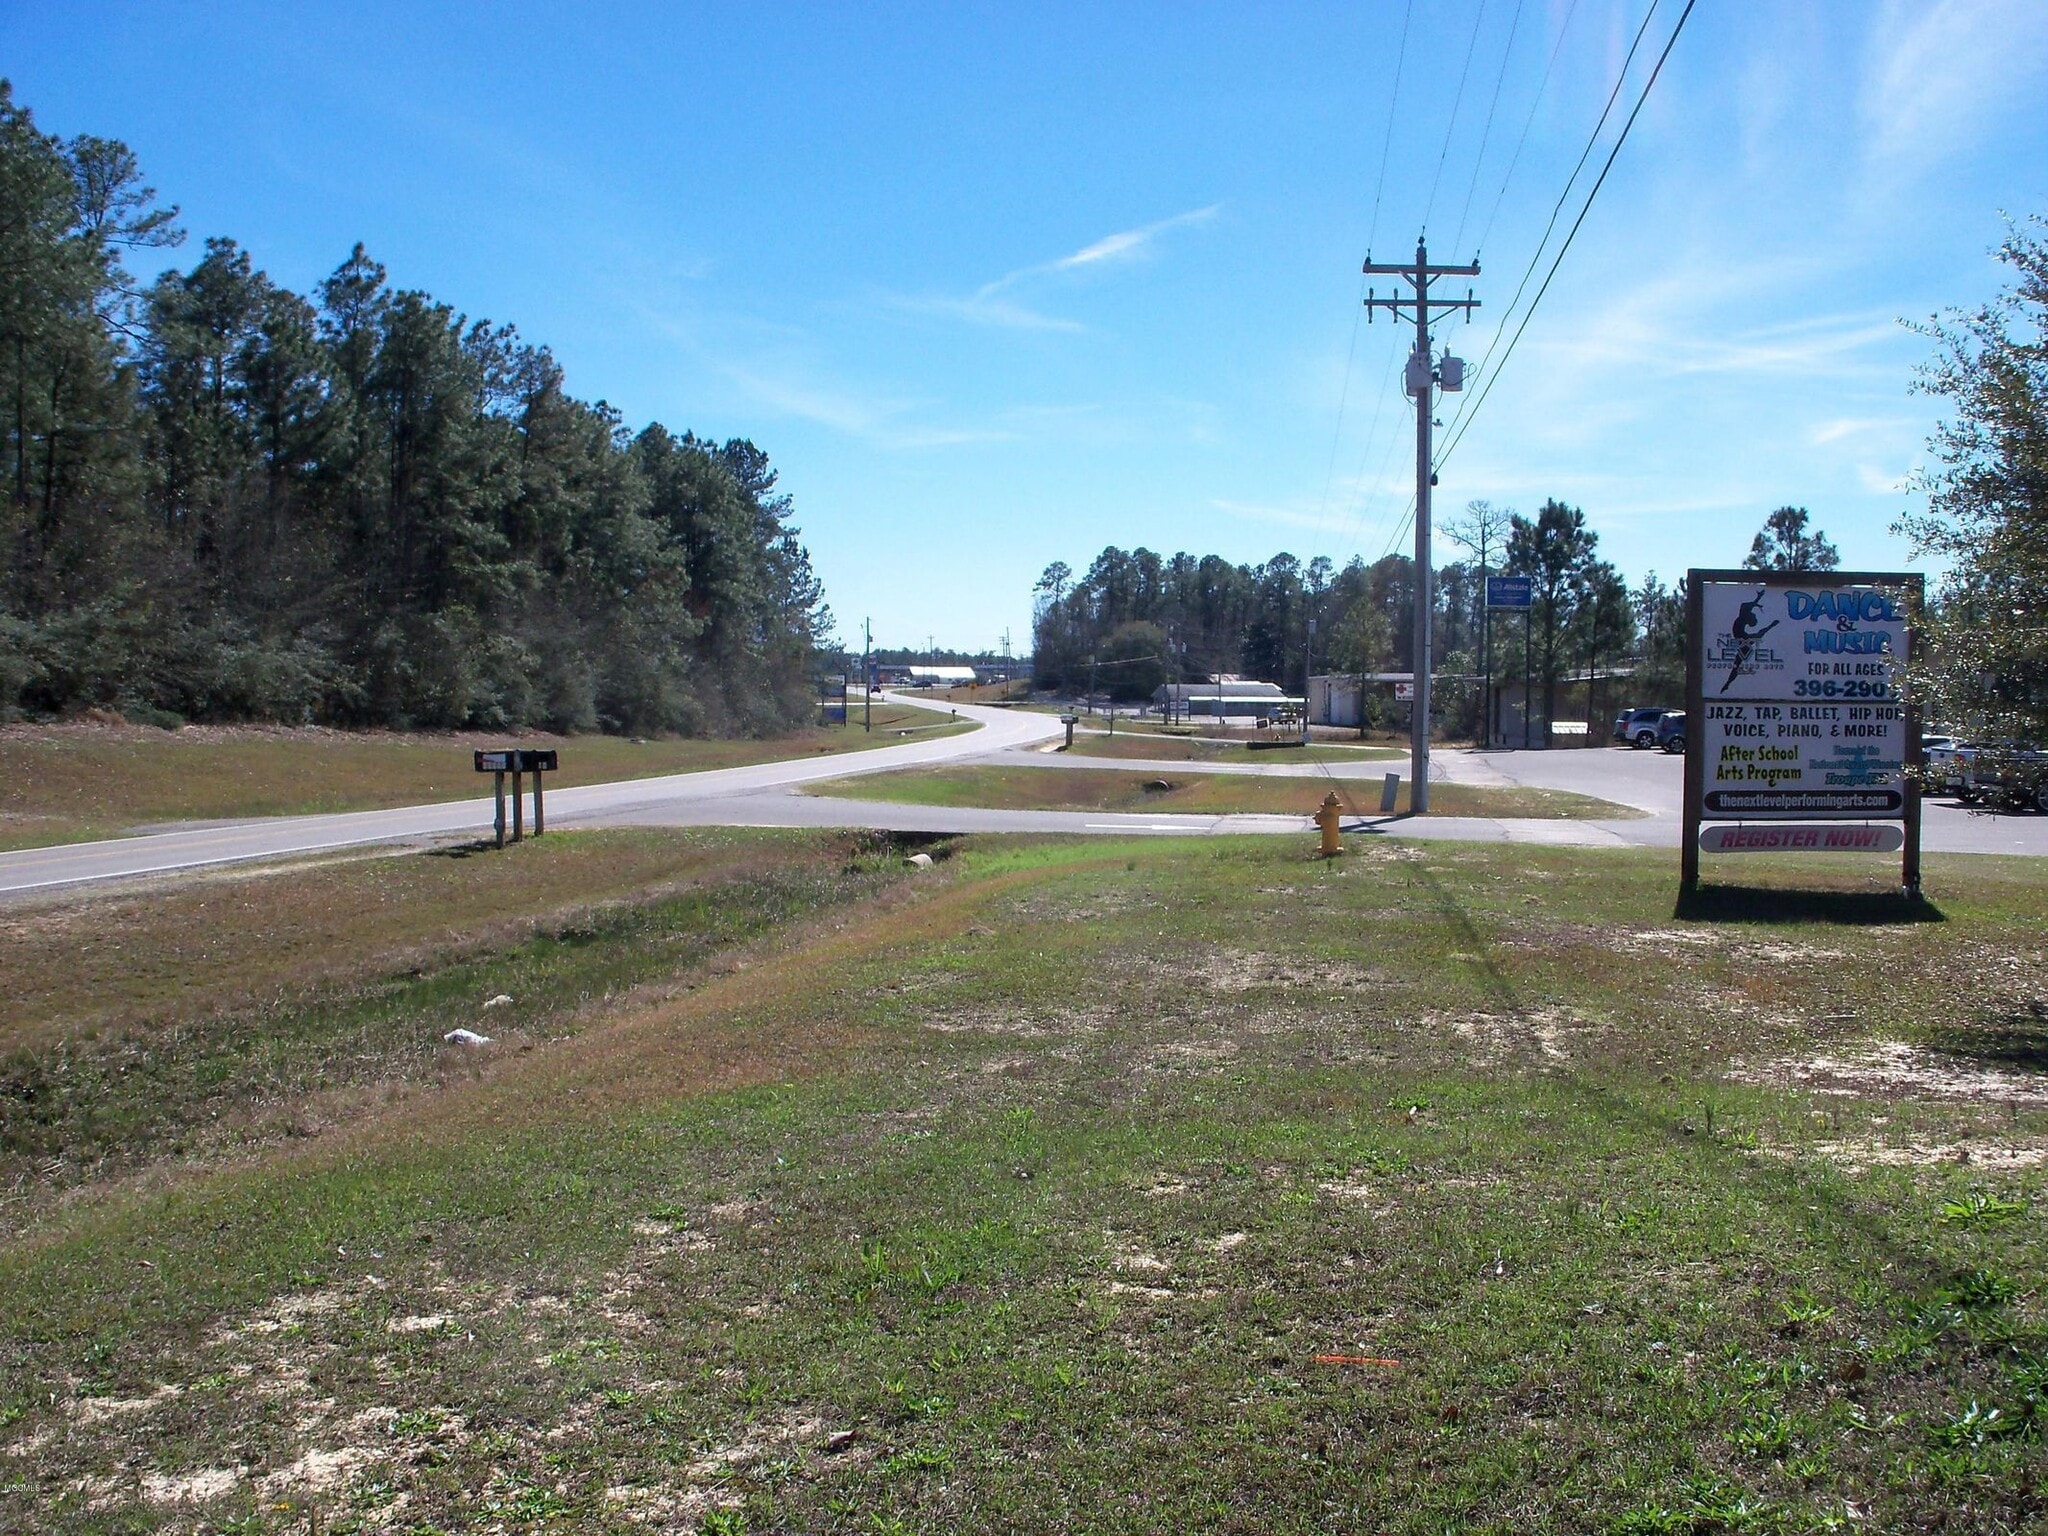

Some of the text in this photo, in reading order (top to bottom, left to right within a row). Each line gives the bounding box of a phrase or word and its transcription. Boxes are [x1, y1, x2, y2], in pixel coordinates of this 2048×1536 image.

[1836, 616, 1857, 631] &
[1804, 630, 1892, 655] MUSIC
[1707, 648, 1785, 662] LEVEL
[1808, 662, 1884, 676] FOR ALL AGES
[1707, 706, 1747, 721] JAZZ,
[1754, 707, 1782, 721] TAP,
[1790, 707, 1840, 721] BALLET,
[1849, 707, 1871, 720] HIP
[1724, 724, 1887, 739] VOICE, PIANO, & MORE!
[1720, 745, 1798, 761] After School
[1716, 765, 1743, 780] Arts
[1747, 764, 1801, 787] Program
[1719, 793, 1888, 809] thenextlevelperformingarts.com
[1720, 831, 1882, 848] REGISTER NOW!
